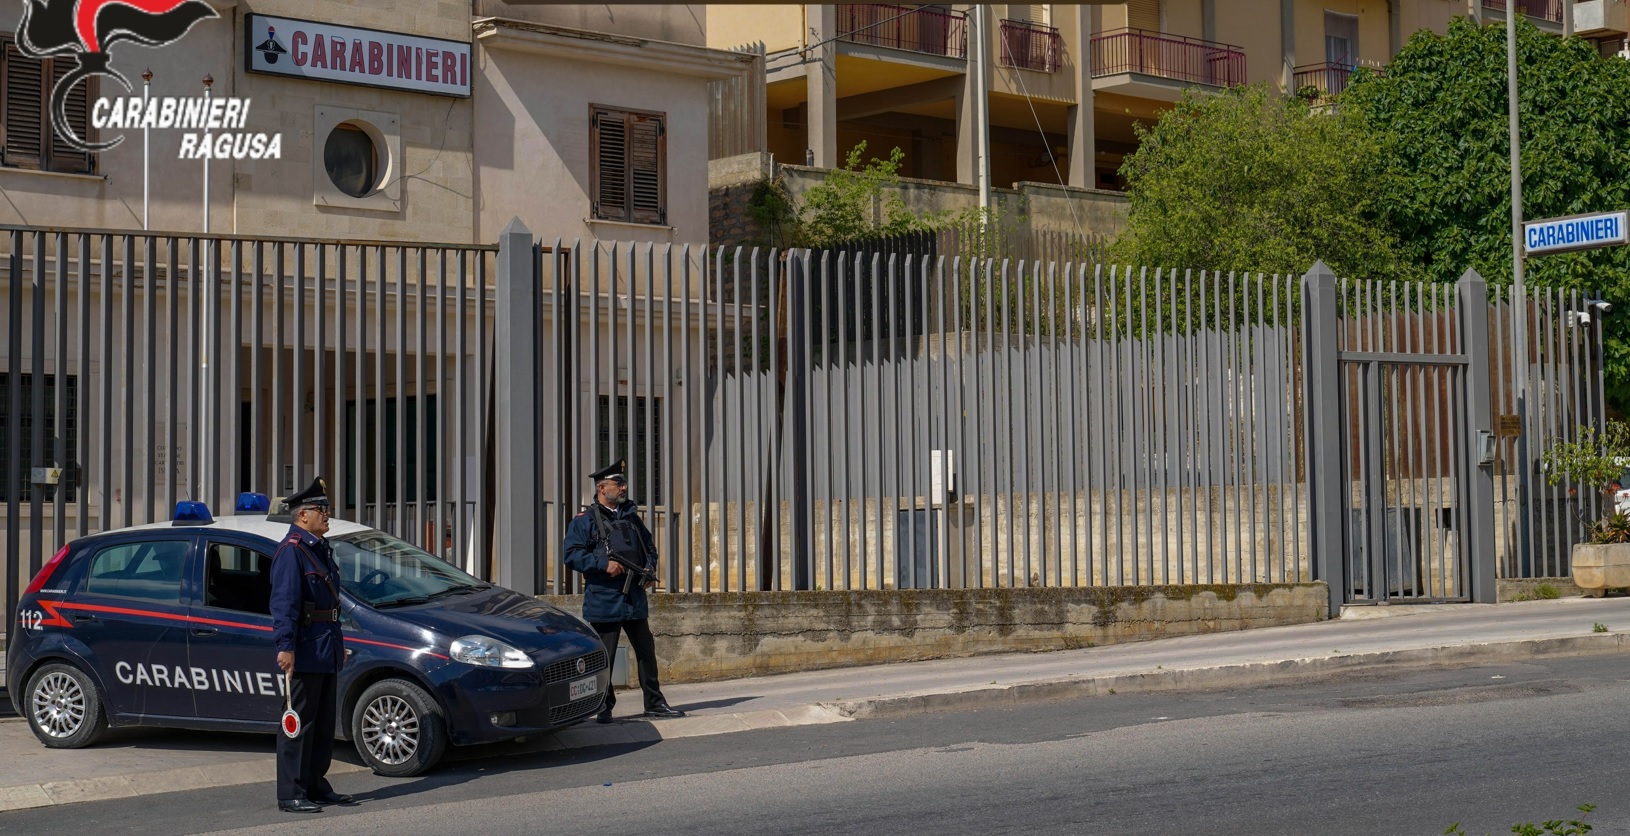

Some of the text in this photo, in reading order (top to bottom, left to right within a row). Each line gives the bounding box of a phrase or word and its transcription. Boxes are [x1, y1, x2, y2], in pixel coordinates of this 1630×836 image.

[292, 30, 467, 86] CARABINIERI
[1528, 217, 1619, 248] CARABINIERI
[20, 609, 43, 630] 112
[115, 660, 285, 696] CARABINIE
